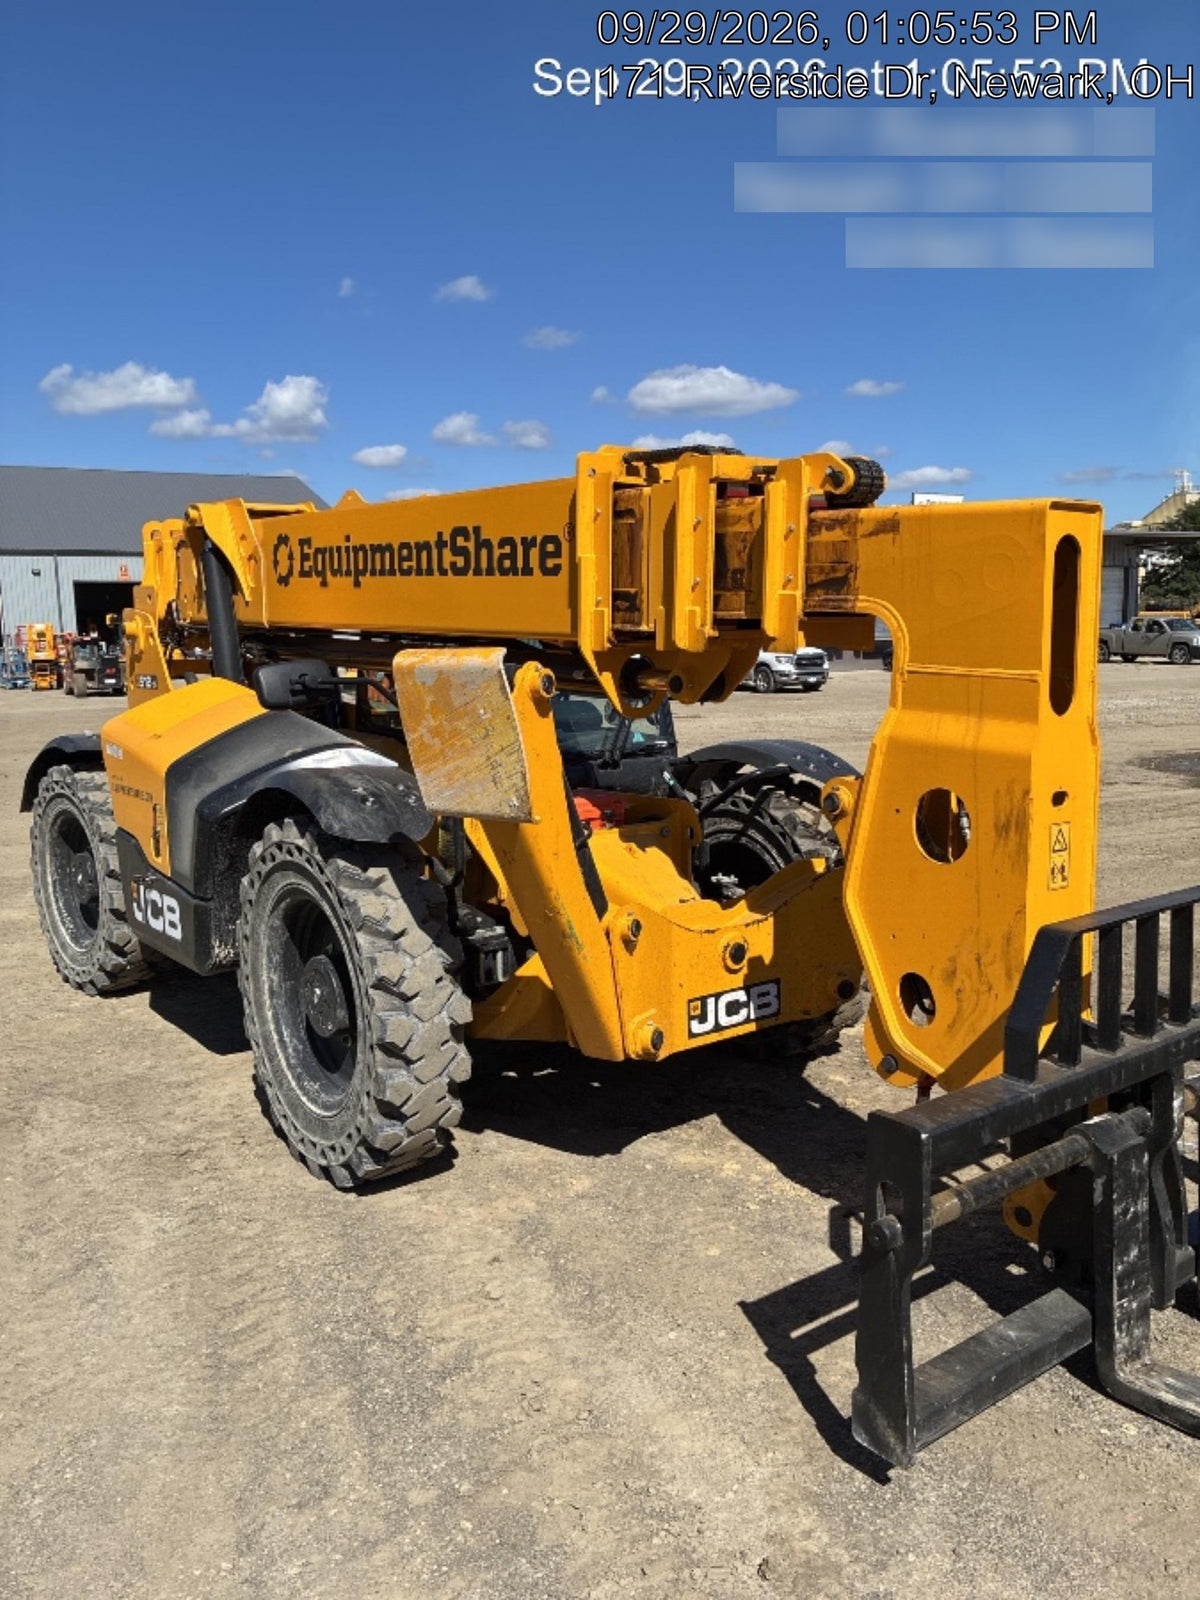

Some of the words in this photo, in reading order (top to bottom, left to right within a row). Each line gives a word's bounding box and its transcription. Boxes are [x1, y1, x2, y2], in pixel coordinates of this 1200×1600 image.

[298, 525, 563, 588] EquipmentShare
[132, 884, 183, 942] JCB
[690, 982, 780, 1034] JCB
